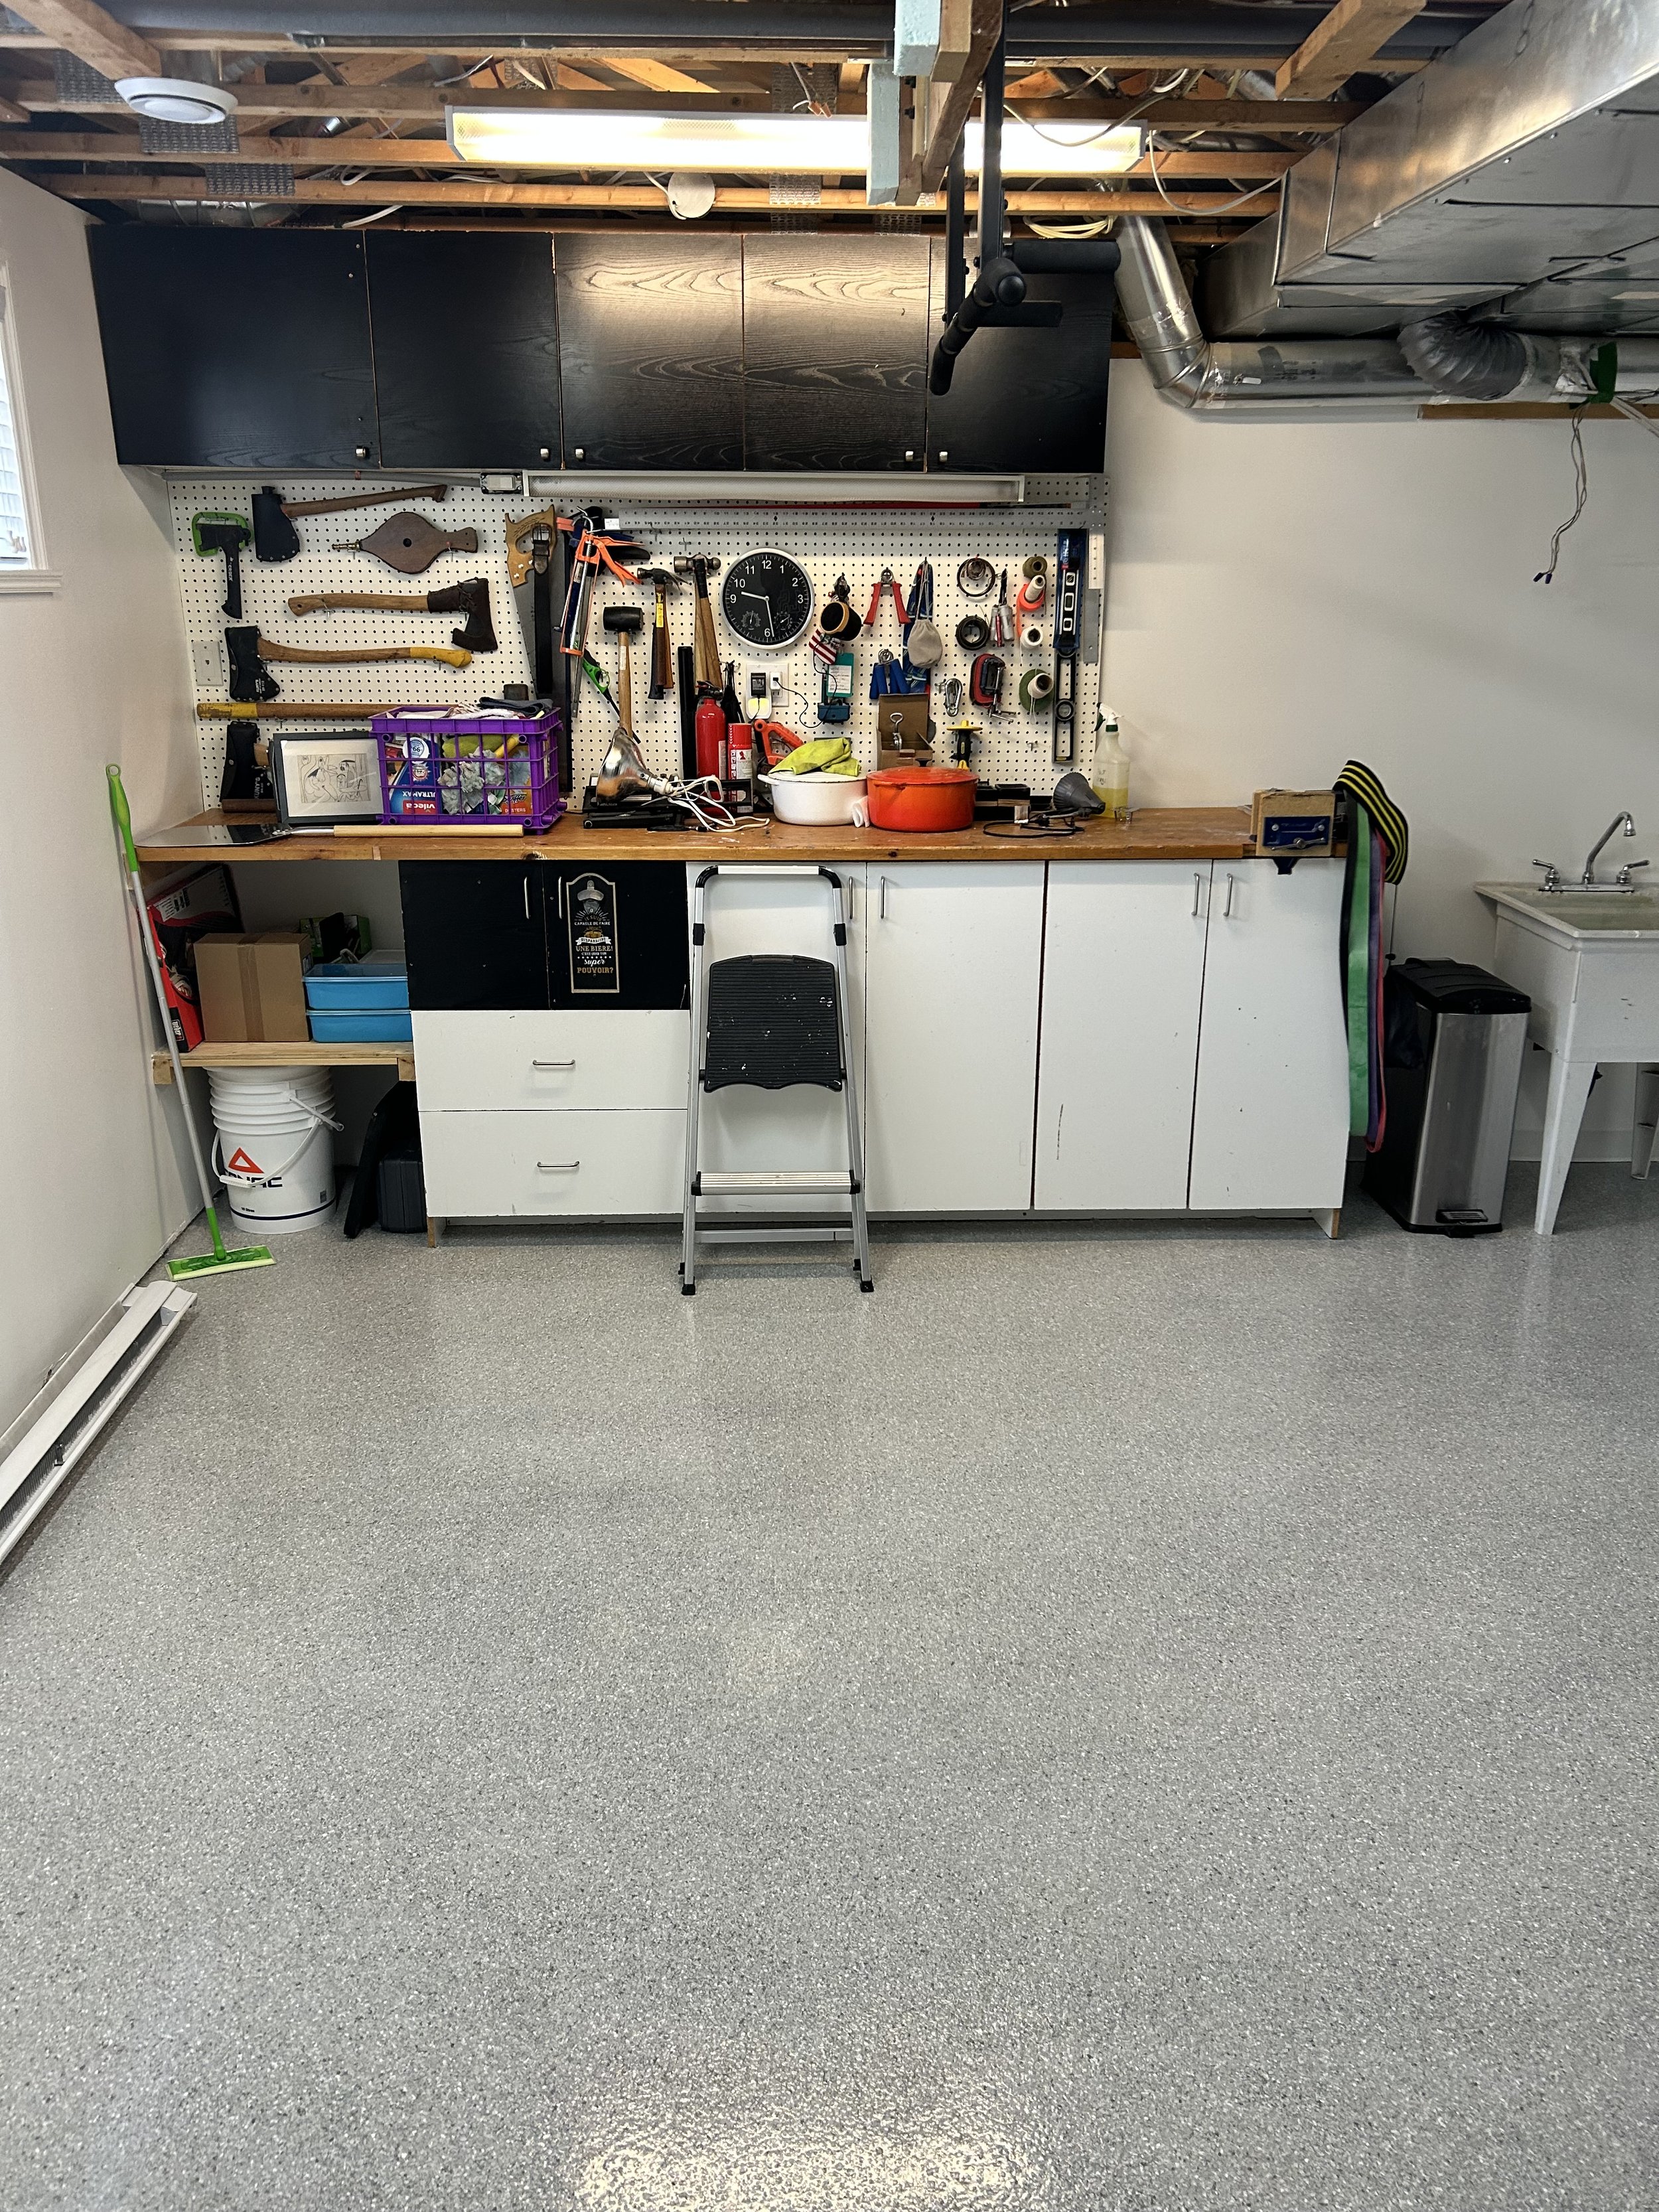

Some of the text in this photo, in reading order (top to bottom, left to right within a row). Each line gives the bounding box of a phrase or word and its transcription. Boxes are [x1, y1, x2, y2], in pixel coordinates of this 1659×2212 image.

[762, 560, 772, 569] 12
[745, 565, 755, 575] 11
[780, 565, 784, 574] 1
[734, 579, 746, 588] 10
[792, 577, 798, 587] 2
[730, 594, 737, 603] 9
[797, 594, 804, 603] 3
[764, 628, 770, 637] 6
[584, 958, 605, 967] super
